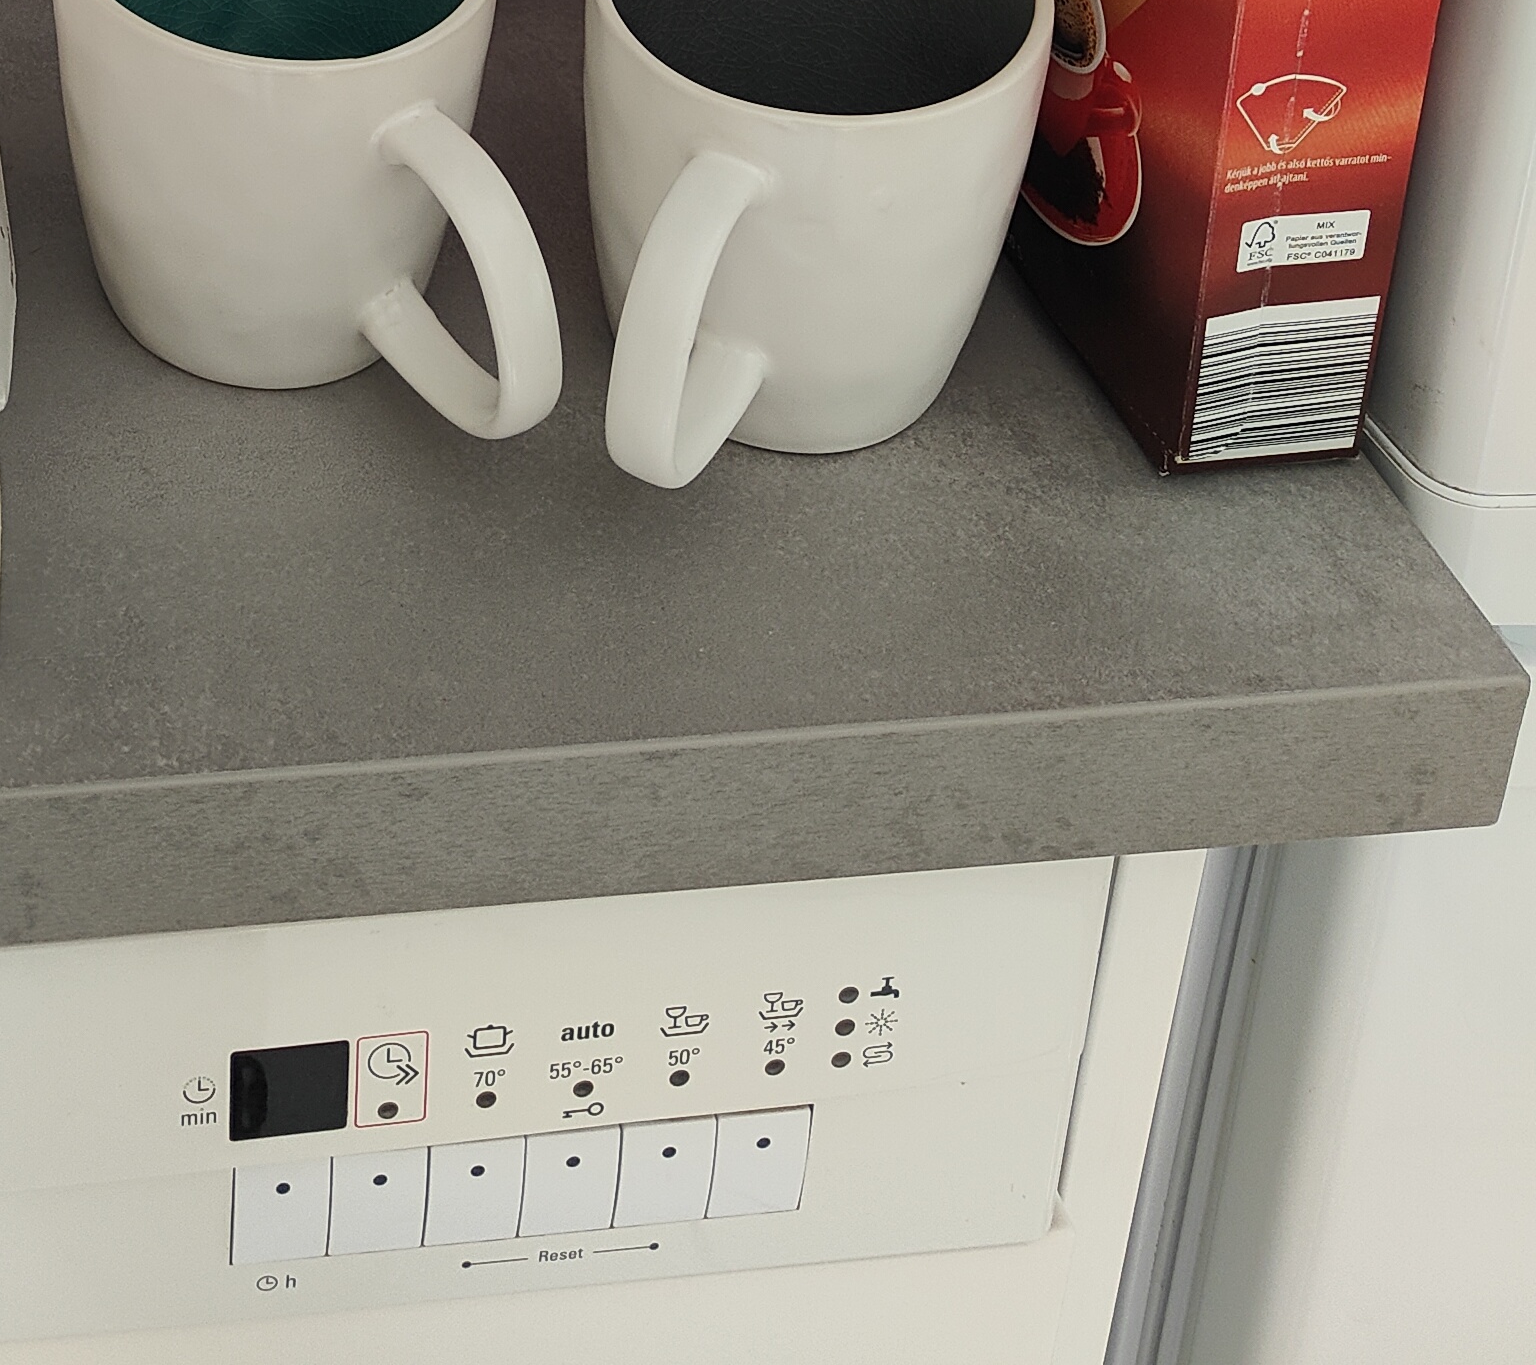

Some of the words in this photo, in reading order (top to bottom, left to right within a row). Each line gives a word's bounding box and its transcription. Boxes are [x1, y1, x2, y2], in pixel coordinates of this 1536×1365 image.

[1316, 220, 1336, 230] MIX
[1248, 248, 1274, 261] FSC
[1314, 248, 1356, 259] C041179
[561, 1021, 615, 1041] auto
[763, 1037, 796, 1055] 45°
[667, 1047, 700, 1066] 50°
[549, 1056, 624, 1080] 55°-65°
[473, 1069, 506, 1088] 70°
[181, 1108, 217, 1127] min
[538, 1248, 584, 1263] Reset
[285, 1274, 297, 1288] h
